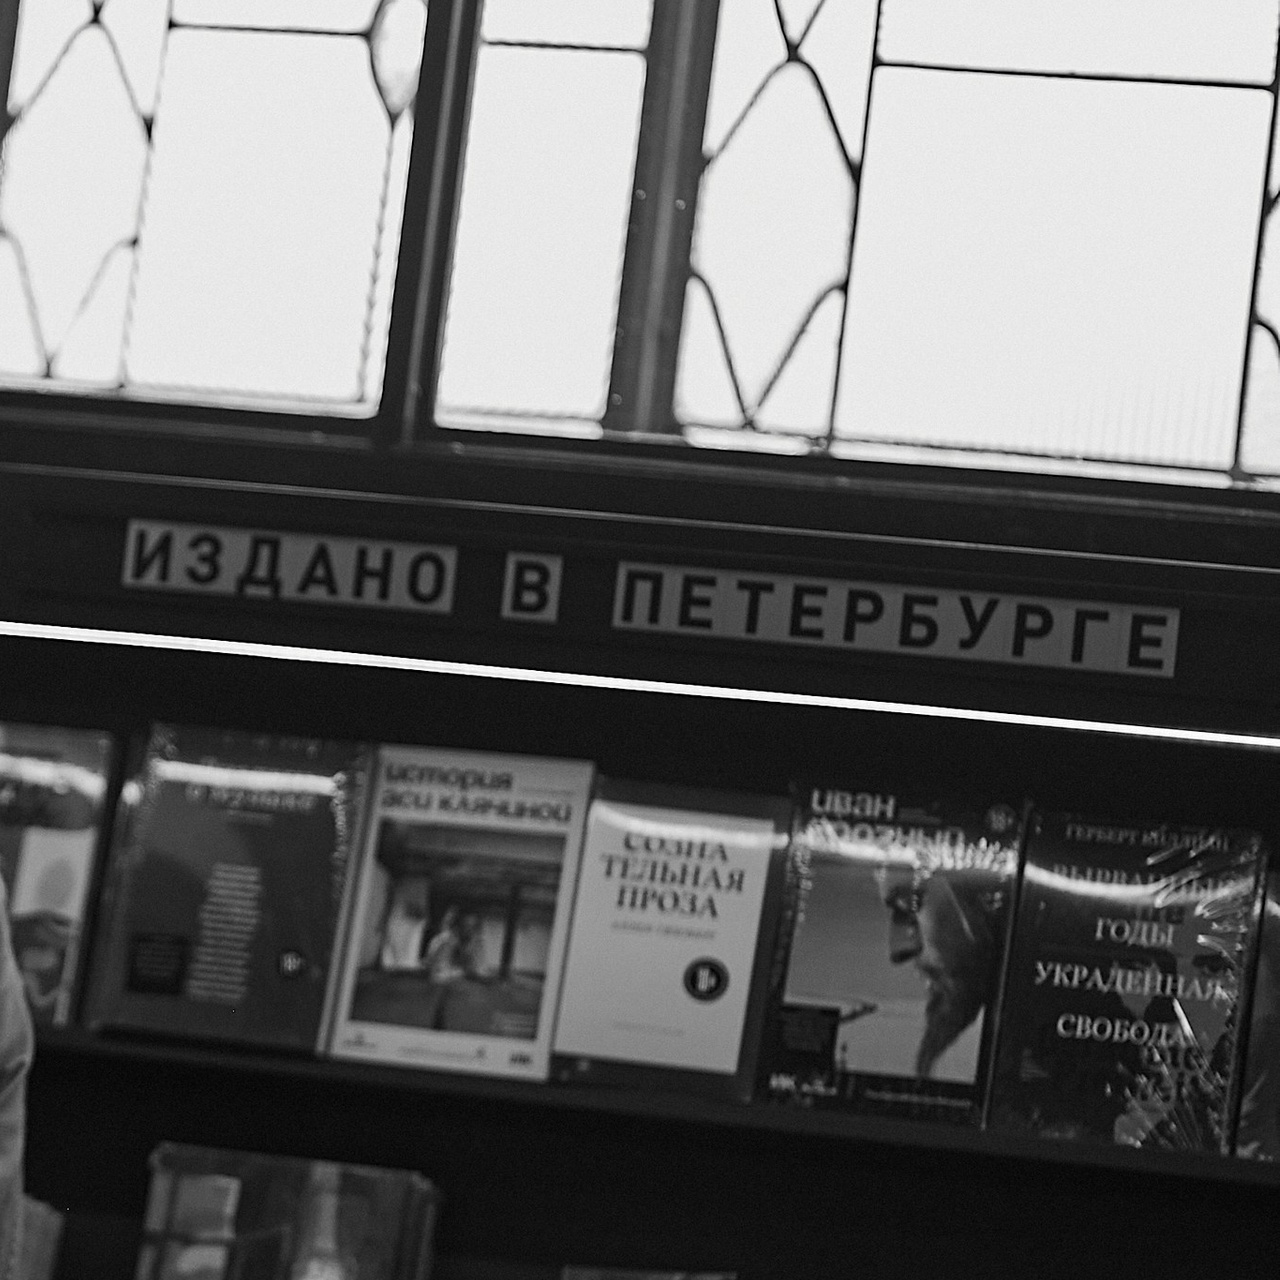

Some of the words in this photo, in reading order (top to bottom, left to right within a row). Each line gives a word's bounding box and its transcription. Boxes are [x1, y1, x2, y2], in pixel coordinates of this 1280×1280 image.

[131, 529, 446, 605] ИЗДАНО
[512, 563, 552, 613] В
[623, 570, 1168, 670] ПЕТЕРБУРГЕ
[600, 852, 747, 895] ТЕЛЬНАЯ
[615, 883, 718, 920] ПРОЗА
[1093, 916, 1175, 948] ГОДЫ
[1056, 1012, 1188, 1048] СВОБОДА
